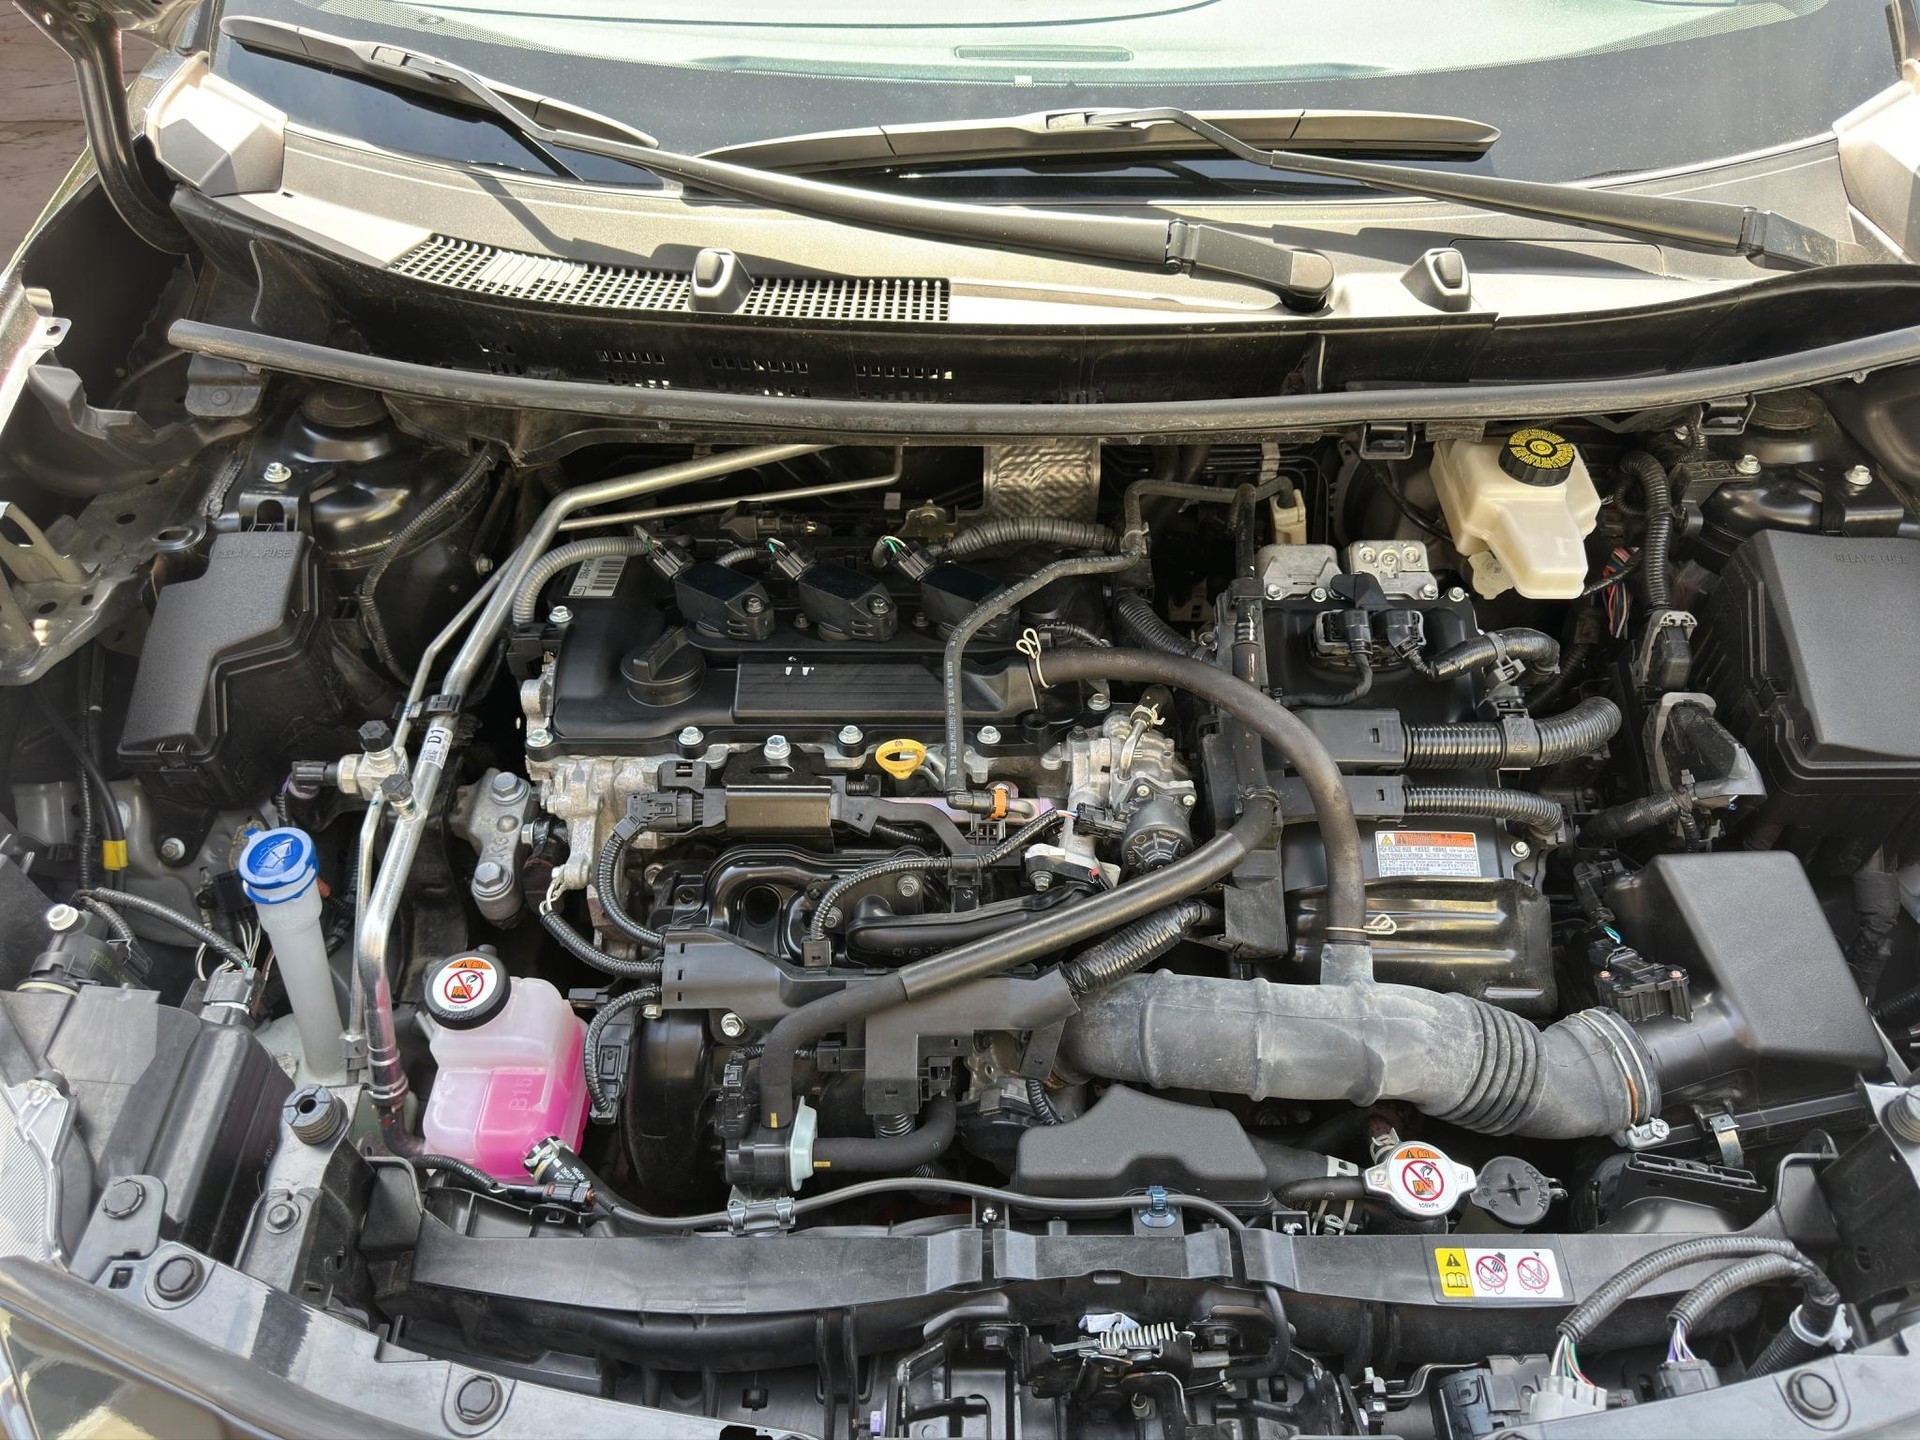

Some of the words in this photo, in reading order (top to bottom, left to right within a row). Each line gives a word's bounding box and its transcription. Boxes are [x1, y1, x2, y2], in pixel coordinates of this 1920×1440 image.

[262, 547, 293, 559] FUSE
[427, 729, 445, 744] D1
[1523, 1164, 1550, 1212] COOLANT
